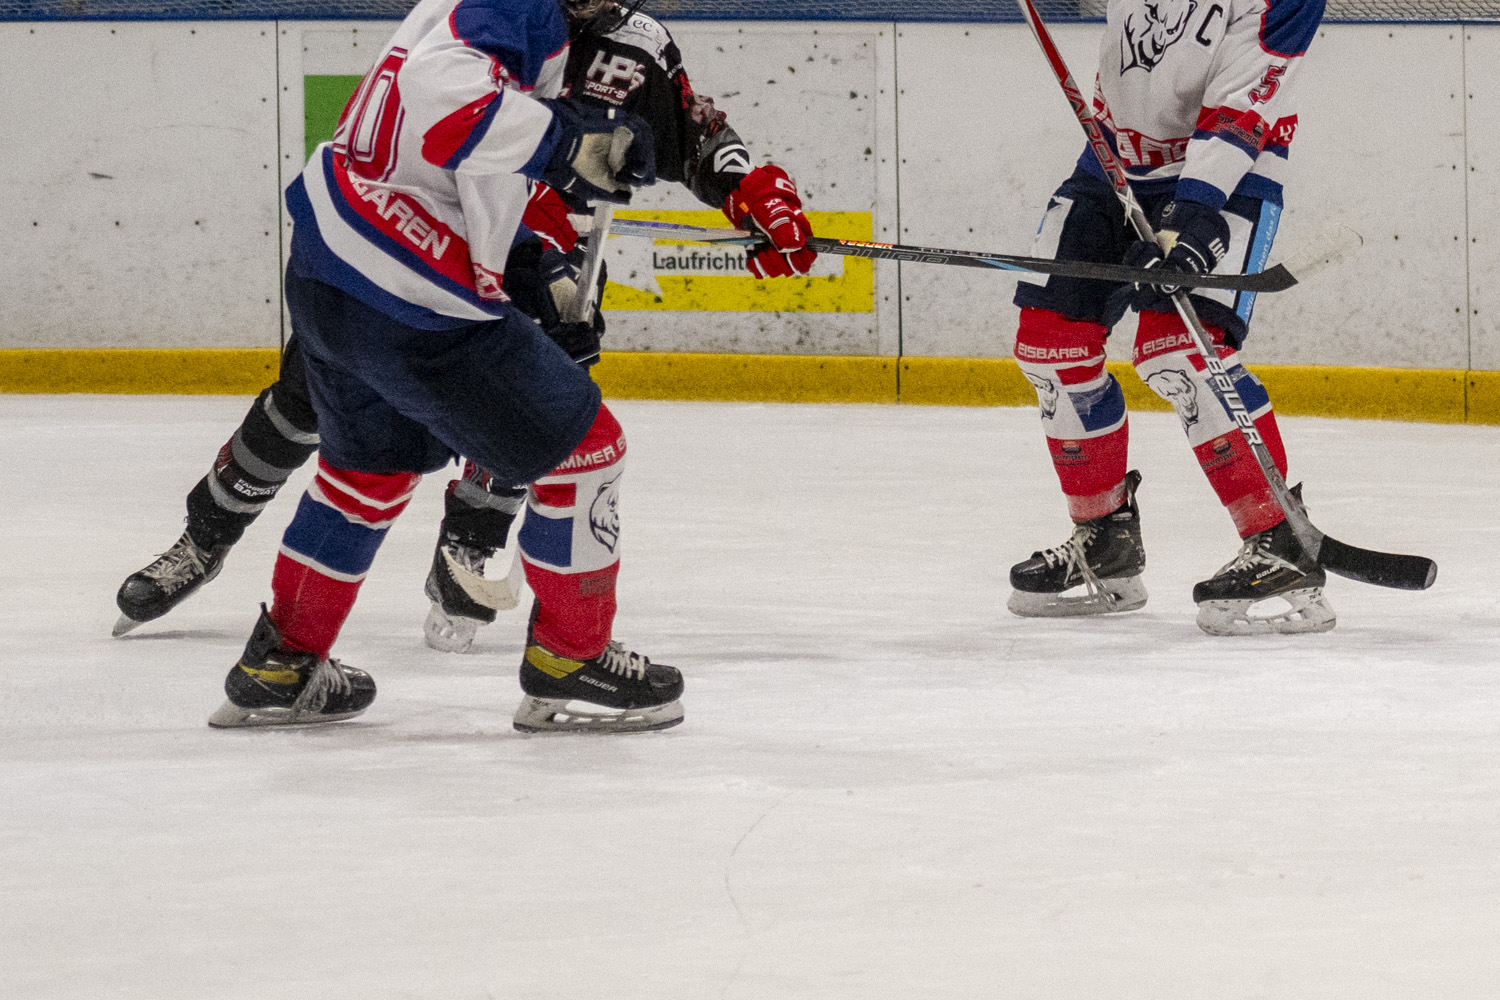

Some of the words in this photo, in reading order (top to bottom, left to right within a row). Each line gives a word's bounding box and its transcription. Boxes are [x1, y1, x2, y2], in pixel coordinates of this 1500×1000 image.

[1196, 3, 1223, 47] C
[1247, 64, 1288, 106] 5
[1061, 71, 1129, 189] VAPOR
[1206, 357, 1264, 446] BAUER
[578, 674, 618, 693] BAUER
